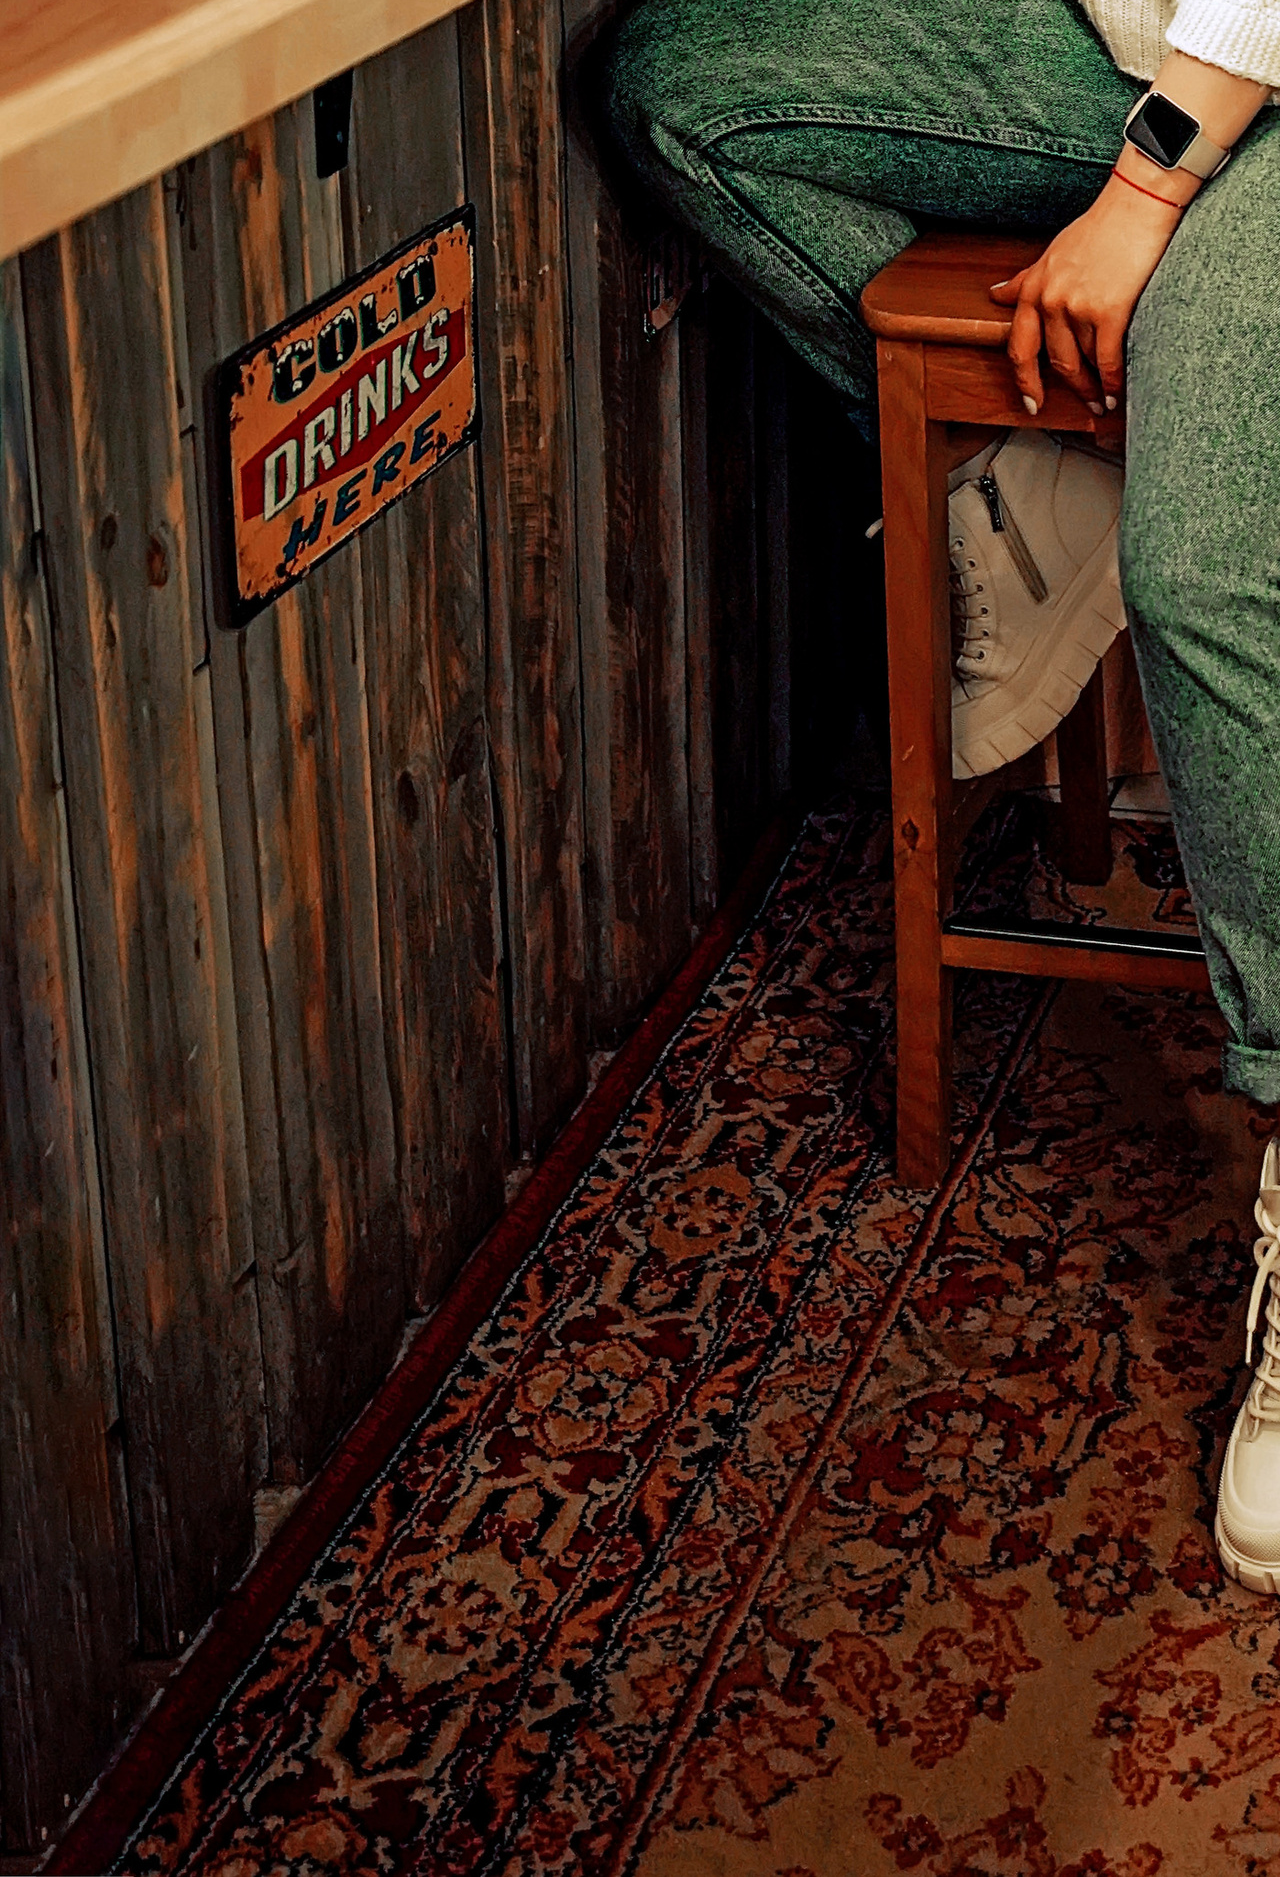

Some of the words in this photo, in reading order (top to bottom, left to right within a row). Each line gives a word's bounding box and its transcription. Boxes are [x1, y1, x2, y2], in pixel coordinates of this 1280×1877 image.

[272, 252, 437, 404] COLD
[263, 307, 450, 521] DRINKS
[283, 409, 442, 564] HERE
